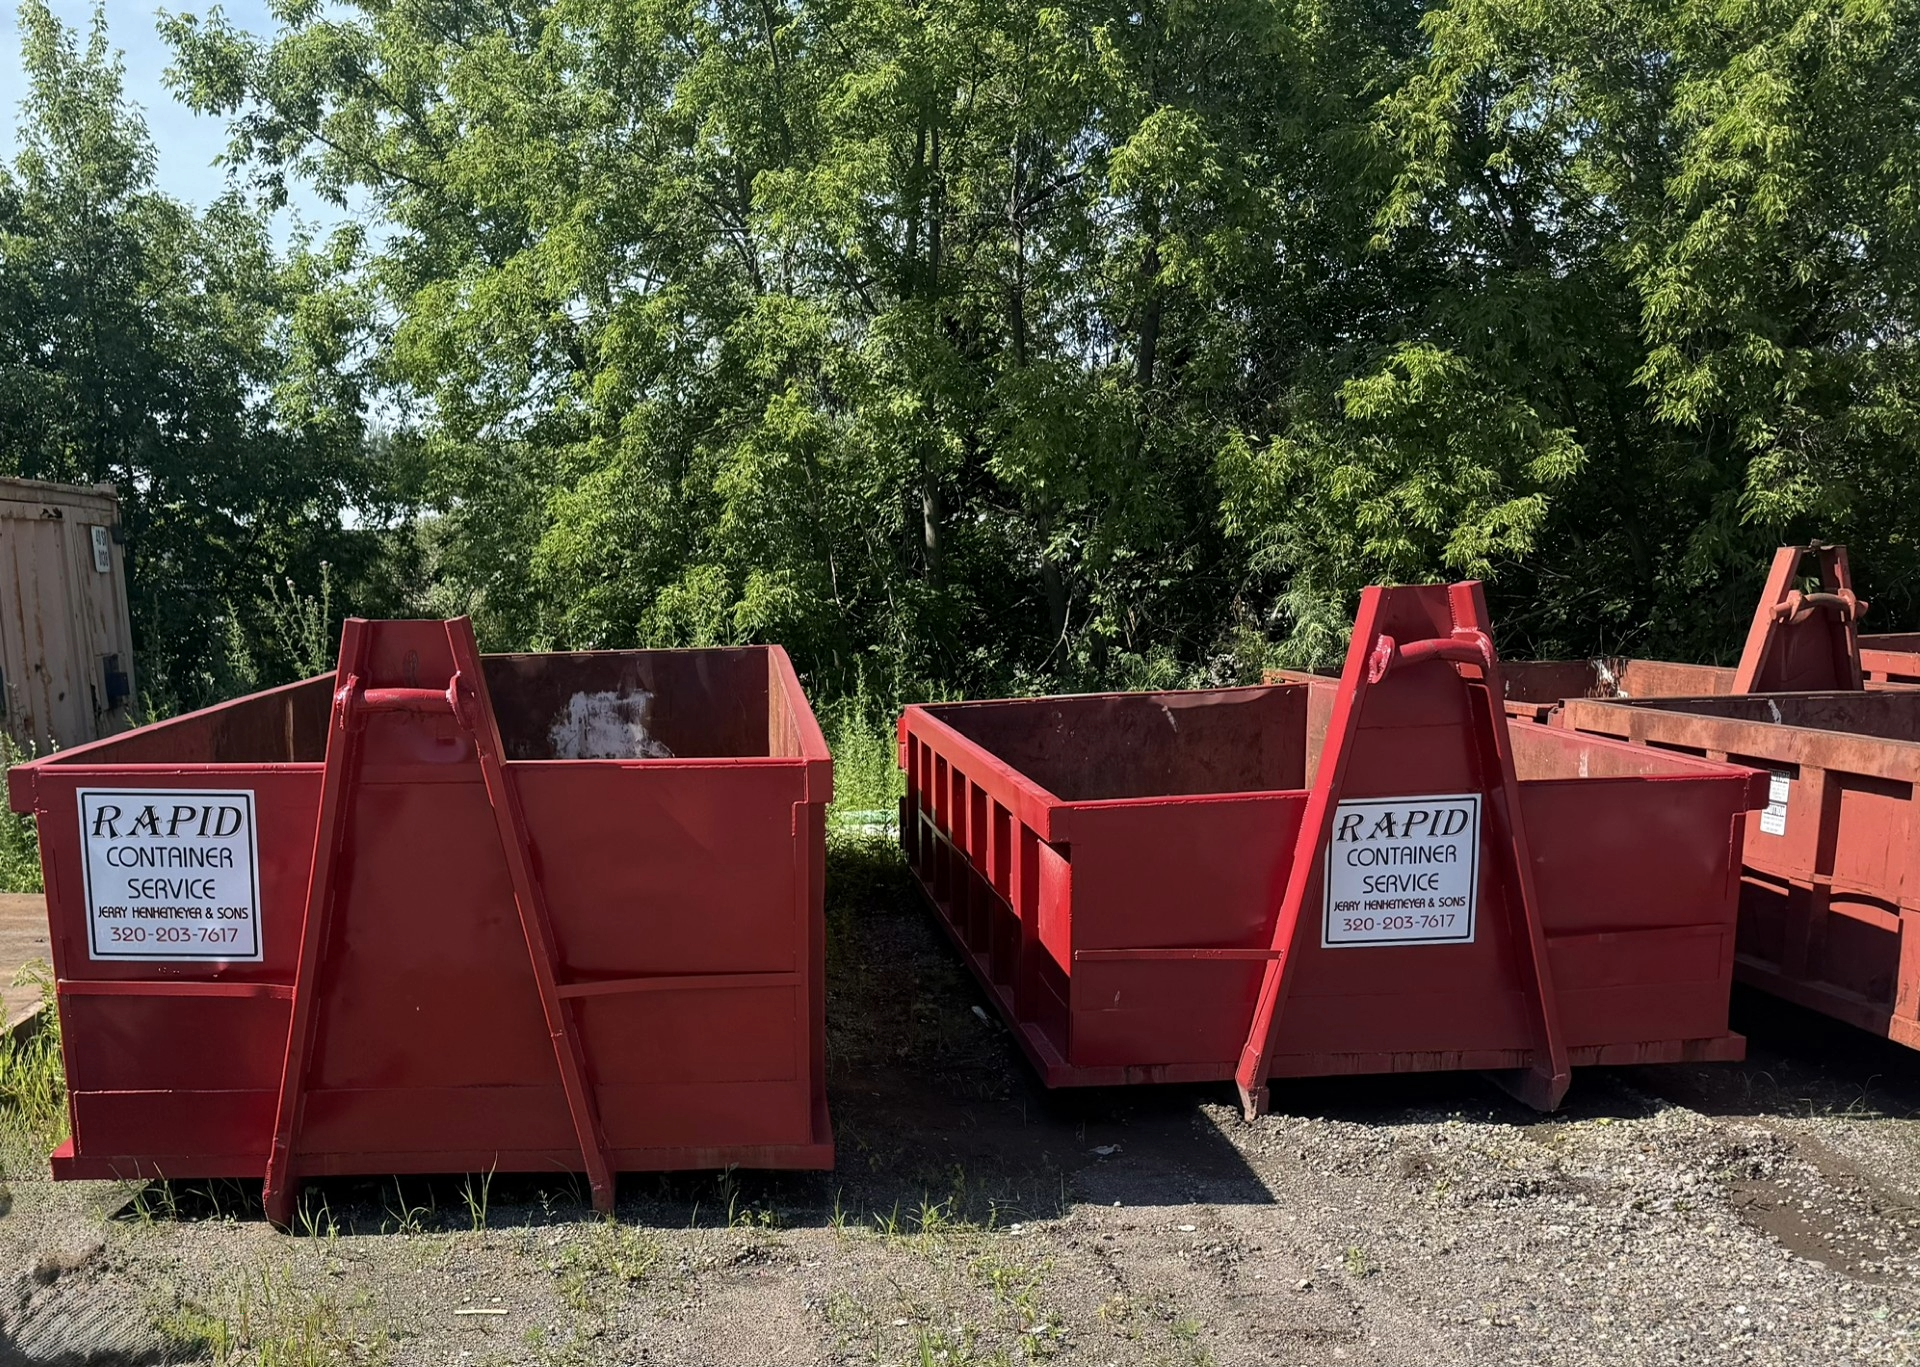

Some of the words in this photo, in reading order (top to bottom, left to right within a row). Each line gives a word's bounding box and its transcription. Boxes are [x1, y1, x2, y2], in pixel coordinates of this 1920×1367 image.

[92, 805, 244, 840] RAPID
[1336, 809, 1470, 844] RAPID
[106, 846, 233, 868] CONTAINER
[1347, 845, 1456, 866] CONTAINER
[128, 878, 215, 899] SERVICE
[1363, 873, 1439, 894] SERVICE
[98, 906, 127, 918] JERRY
[132, 907, 202, 919] HENKEMEYER
[205, 908, 213, 919] &
[217, 907, 248, 919] SONS
[1334, 901, 1360, 911] JERRY
[1364, 898, 1425, 910] HENKEMEYER
[1428, 898, 1435, 907] &
[1439, 897, 1465, 907] SONS
[1343, 914, 1455, 932] 320-203-7617
[110, 927, 238, 942] 320-203-7617
